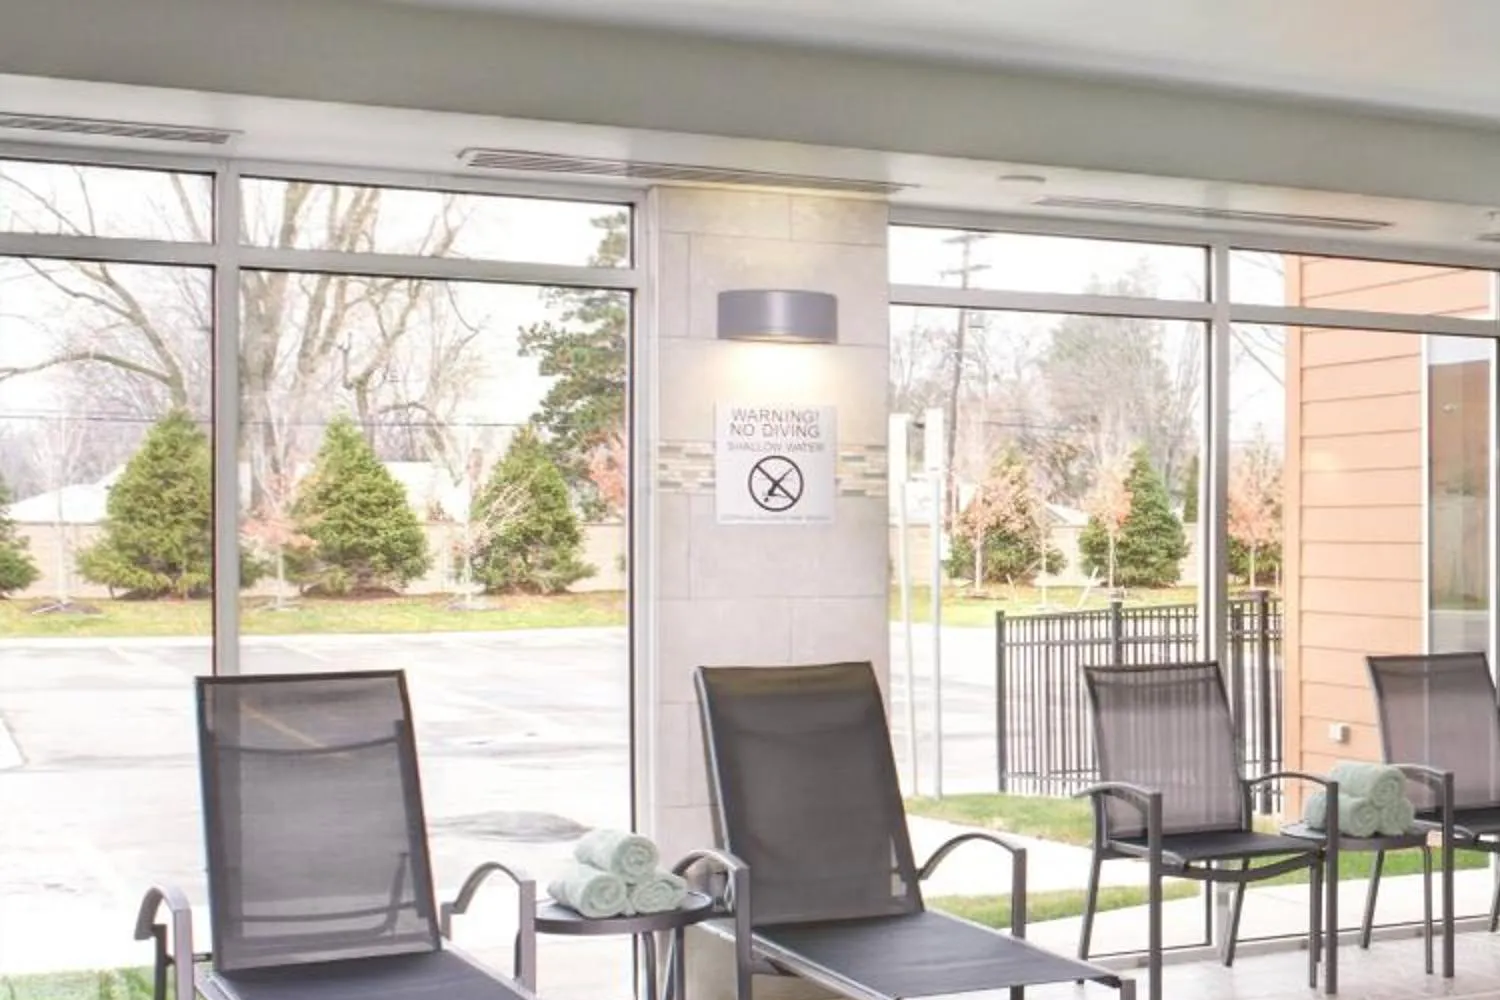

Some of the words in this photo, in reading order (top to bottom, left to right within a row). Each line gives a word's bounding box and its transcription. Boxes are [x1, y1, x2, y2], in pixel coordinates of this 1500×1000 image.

[731, 407, 820, 424] WARNING!
[730, 423, 755, 437] NO
[762, 424, 820, 438] DIVING
